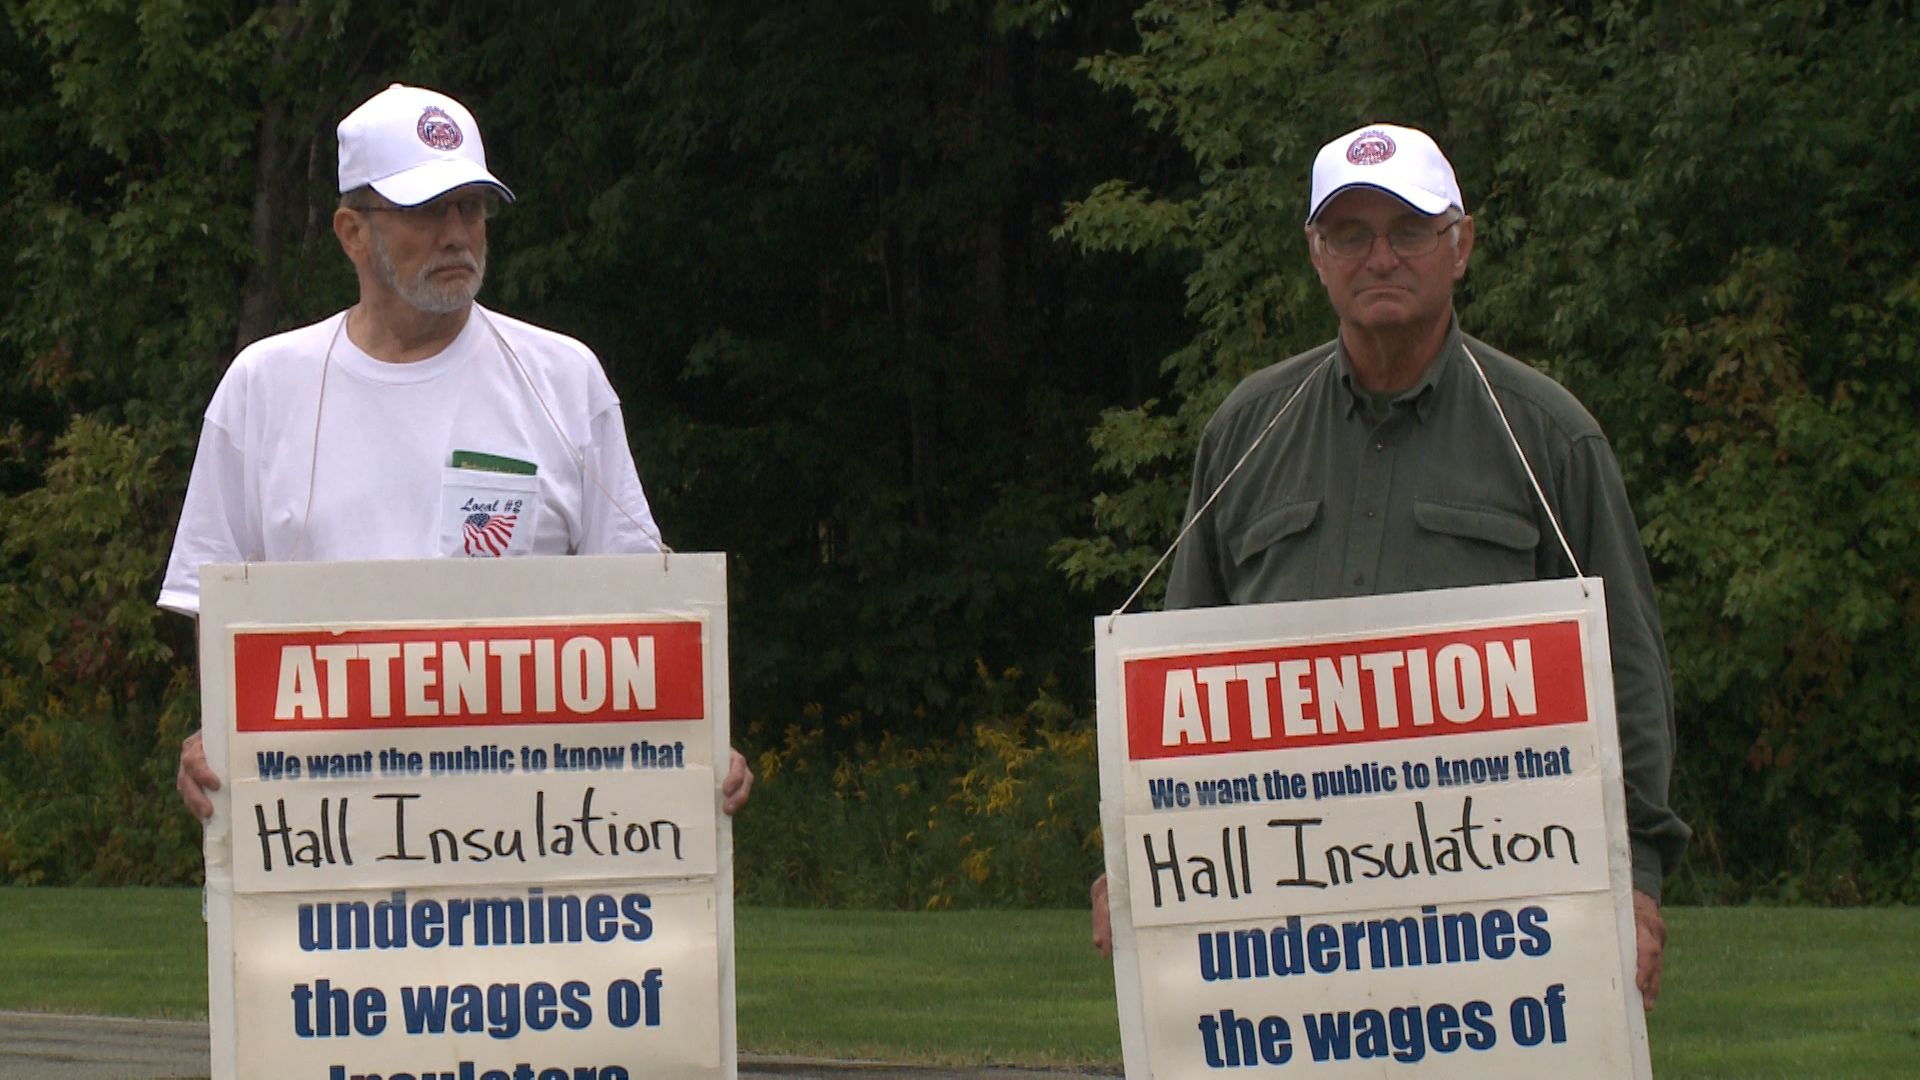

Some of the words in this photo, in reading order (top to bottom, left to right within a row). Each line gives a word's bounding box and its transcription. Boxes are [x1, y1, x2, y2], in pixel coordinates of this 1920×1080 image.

[460, 497, 500, 512] Local
[273, 634, 657, 720] ATTENTION
[1161, 638, 1538, 747] ATTENTION
[256, 750, 301, 781] We
[306, 750, 373, 780] want
[379, 747, 423, 777] the
[429, 745, 515, 776] public
[520, 745, 547, 775] to
[553, 742, 625, 772] know
[630, 739, 685, 770] that
[1148, 777, 1192, 810] We
[1195, 773, 1260, 806] want
[1263, 769, 1307, 801] the
[1312, 762, 1398, 800] public
[1402, 761, 1431, 790] to
[1435, 755, 1509, 787] know
[1515, 745, 1573, 779] that
[254, 797, 354, 872] Hall
[372, 787, 686, 865] Insulation
[1143, 825, 1253, 908] Hall
[1266, 795, 1580, 890] Insulation
[297, 888, 654, 952] undermines
[1198, 904, 1552, 982] undermines
[291, 979, 388, 1038] the
[400, 977, 592, 1040] wages
[607, 968, 663, 1029] of
[1199, 1009, 1292, 1069] the
[1303, 1000, 1497, 1064] wages
[1509, 983, 1568, 1047] of
